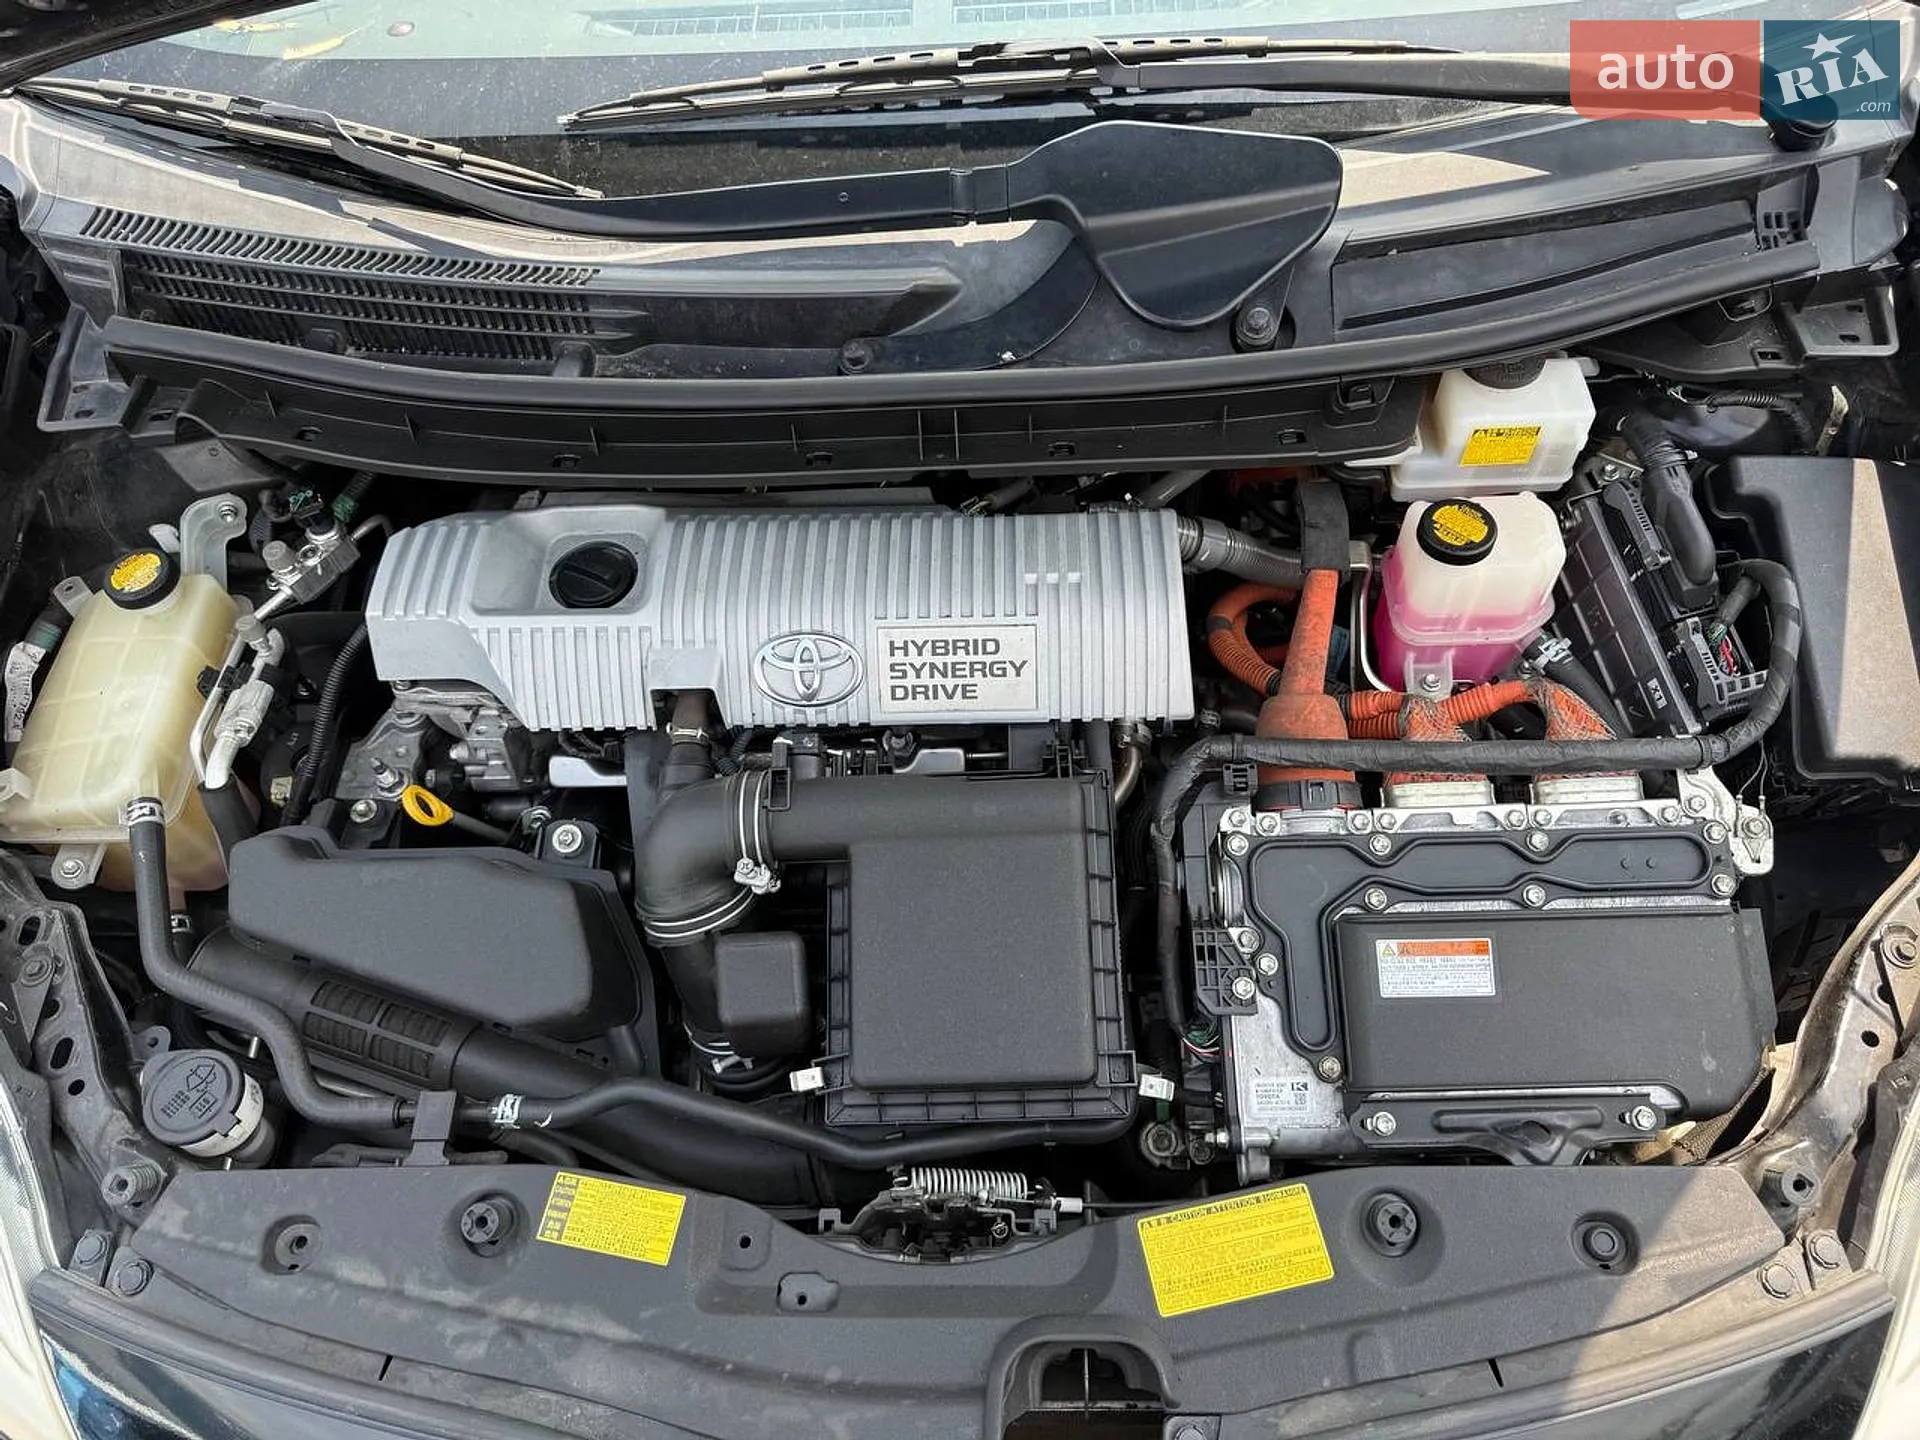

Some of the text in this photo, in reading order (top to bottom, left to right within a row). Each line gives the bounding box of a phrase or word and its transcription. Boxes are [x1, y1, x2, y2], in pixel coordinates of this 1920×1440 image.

[888, 638, 1001, 657] HYBRID
[889, 659, 1029, 680] SYNERGY
[890, 683, 979, 701] DRIVE
